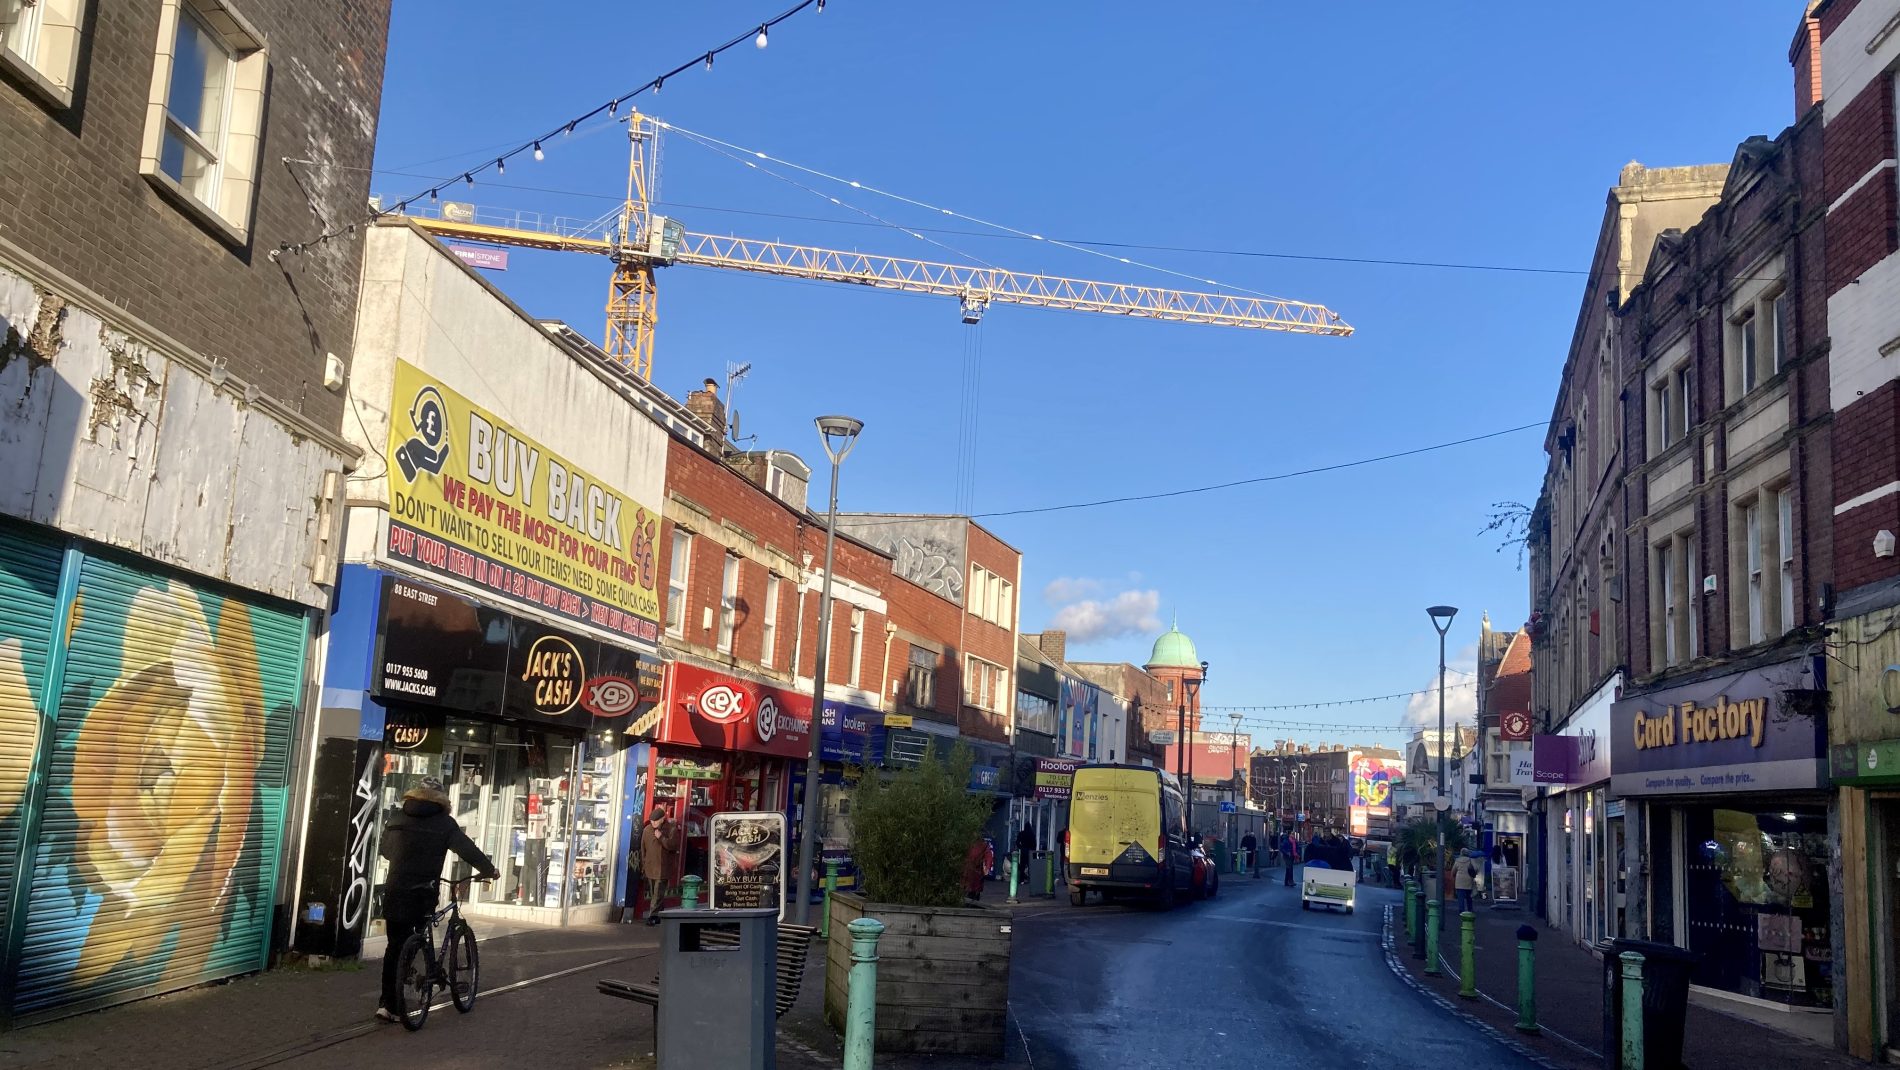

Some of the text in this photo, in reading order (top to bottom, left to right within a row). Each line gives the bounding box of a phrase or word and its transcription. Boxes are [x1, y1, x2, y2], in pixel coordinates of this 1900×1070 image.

[468, 411, 622, 551] BUY BACK
[443, 474, 637, 586] WE PAY THE MOST FOR YOUR ITEMS
[395, 491, 658, 618] DON'T WANT TO SELL YOUR ITEMS? NEED SOME QUICK CASH?
[390, 525, 416, 558] PUT
[416, 534, 447, 569] YOUR
[448, 547, 475, 579] ITEM
[475, 558, 488, 585] IN
[489, 563, 504, 590] ON
[504, 569, 512, 592] A
[512, 572, 526, 598] 28
[526, 577, 544, 603] DAY
[543, 583, 561, 609] BUY
[560, 590, 582, 618] BACK
[591, 601, 609, 626] THEN
[608, 609, 624, 630] BUY
[394, 583, 438, 606] 88 EAST STREET
[386, 663, 428, 680] 0117 955 5608
[522, 650, 572, 682] JACK'S
[384, 678, 437, 697] WWW.JACKS.CASH
[654, 679, 662, 688] BAC
[535, 680, 573, 706] CASH
[821, 708, 836, 718] SH
[821, 717, 835, 726] ANS
[777, 715, 810, 735] EXCHANGE
[842, 715, 866, 732] brokers
[1633, 705, 1676, 751] Card
[1681, 696, 1768, 749] Factory
[394, 728, 421, 745] CASH
[1040, 761, 1076, 772] Hooton
[1536, 770, 1564, 779] Scope
[1700, 774, 1724, 787] Compare
[1725, 771, 1734, 784] the
[735, 835, 761, 844] CASH
